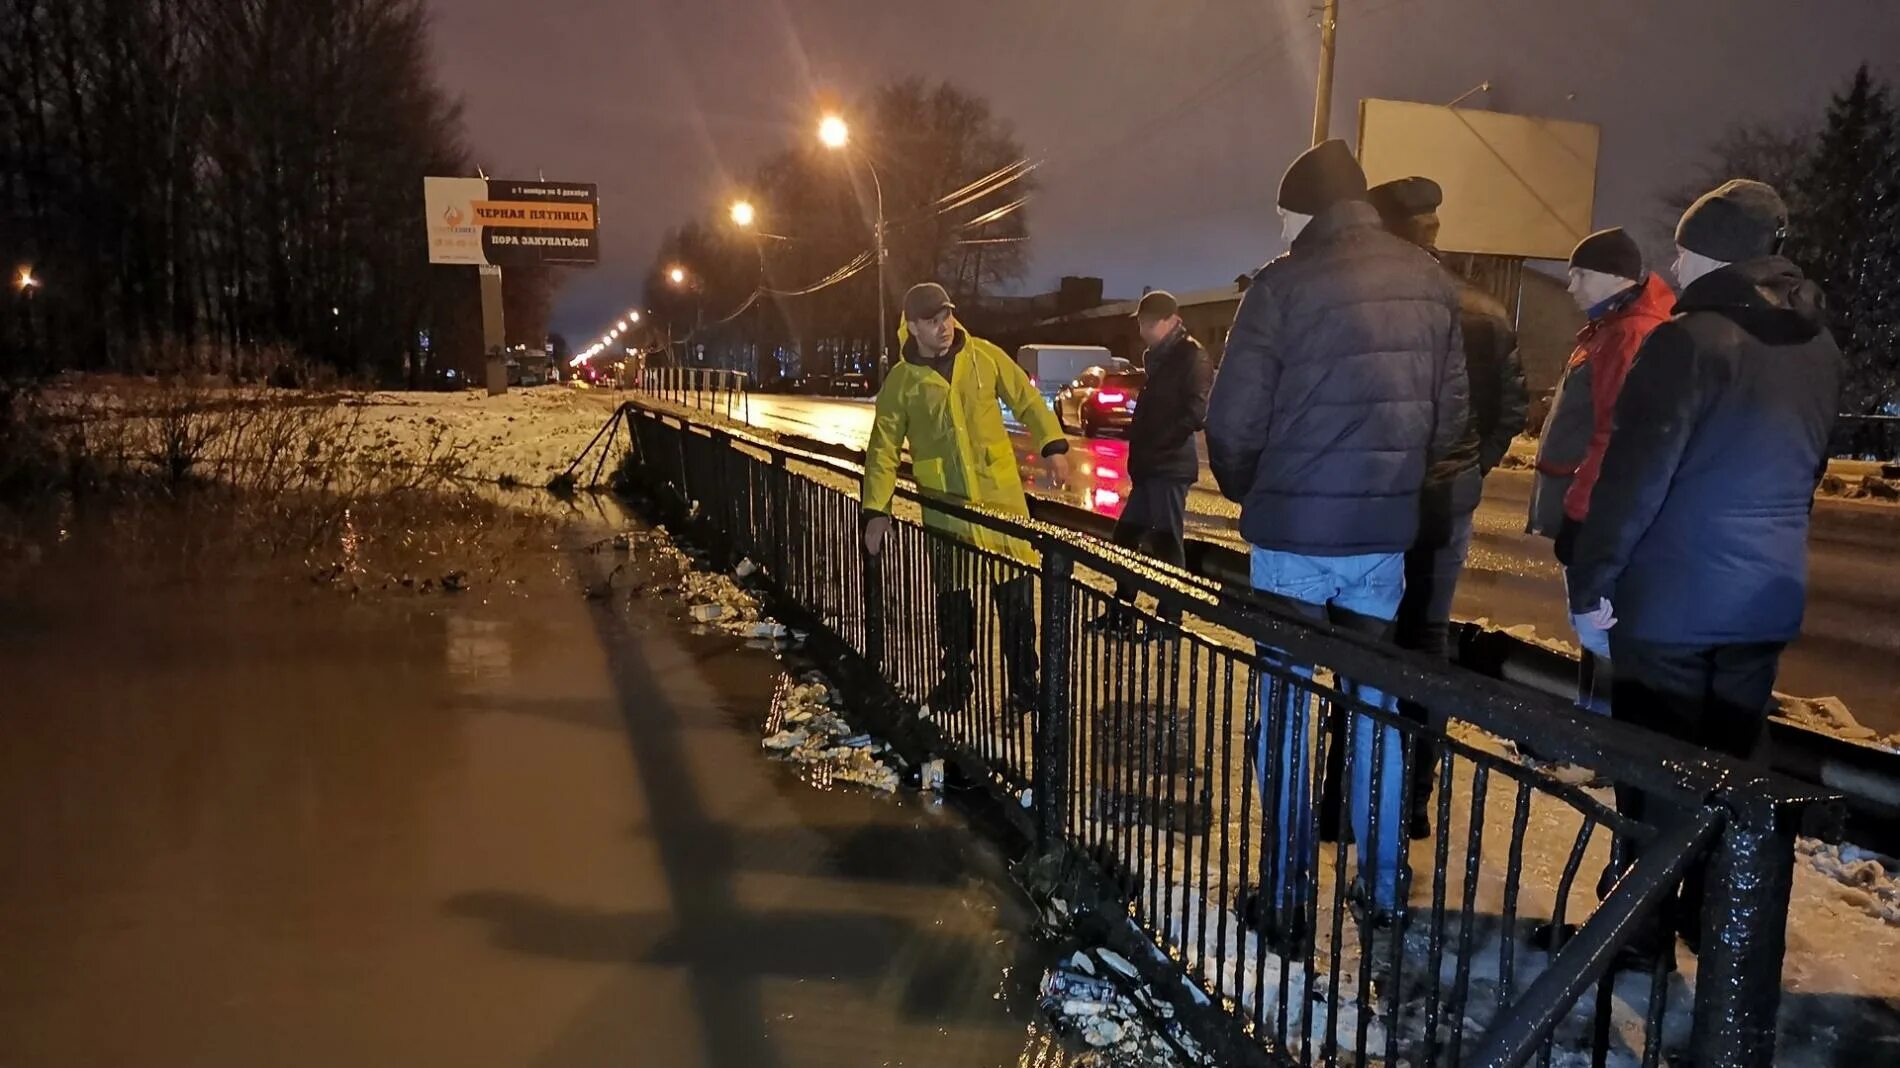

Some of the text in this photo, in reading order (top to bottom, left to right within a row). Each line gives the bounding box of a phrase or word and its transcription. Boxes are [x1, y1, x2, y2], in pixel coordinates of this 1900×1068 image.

[477, 208, 588, 222] ЧЕРНАЯ ПЯТНИЦА
[492, 235, 589, 247] ПОРА ЗАКУПАТЬСЯ!
